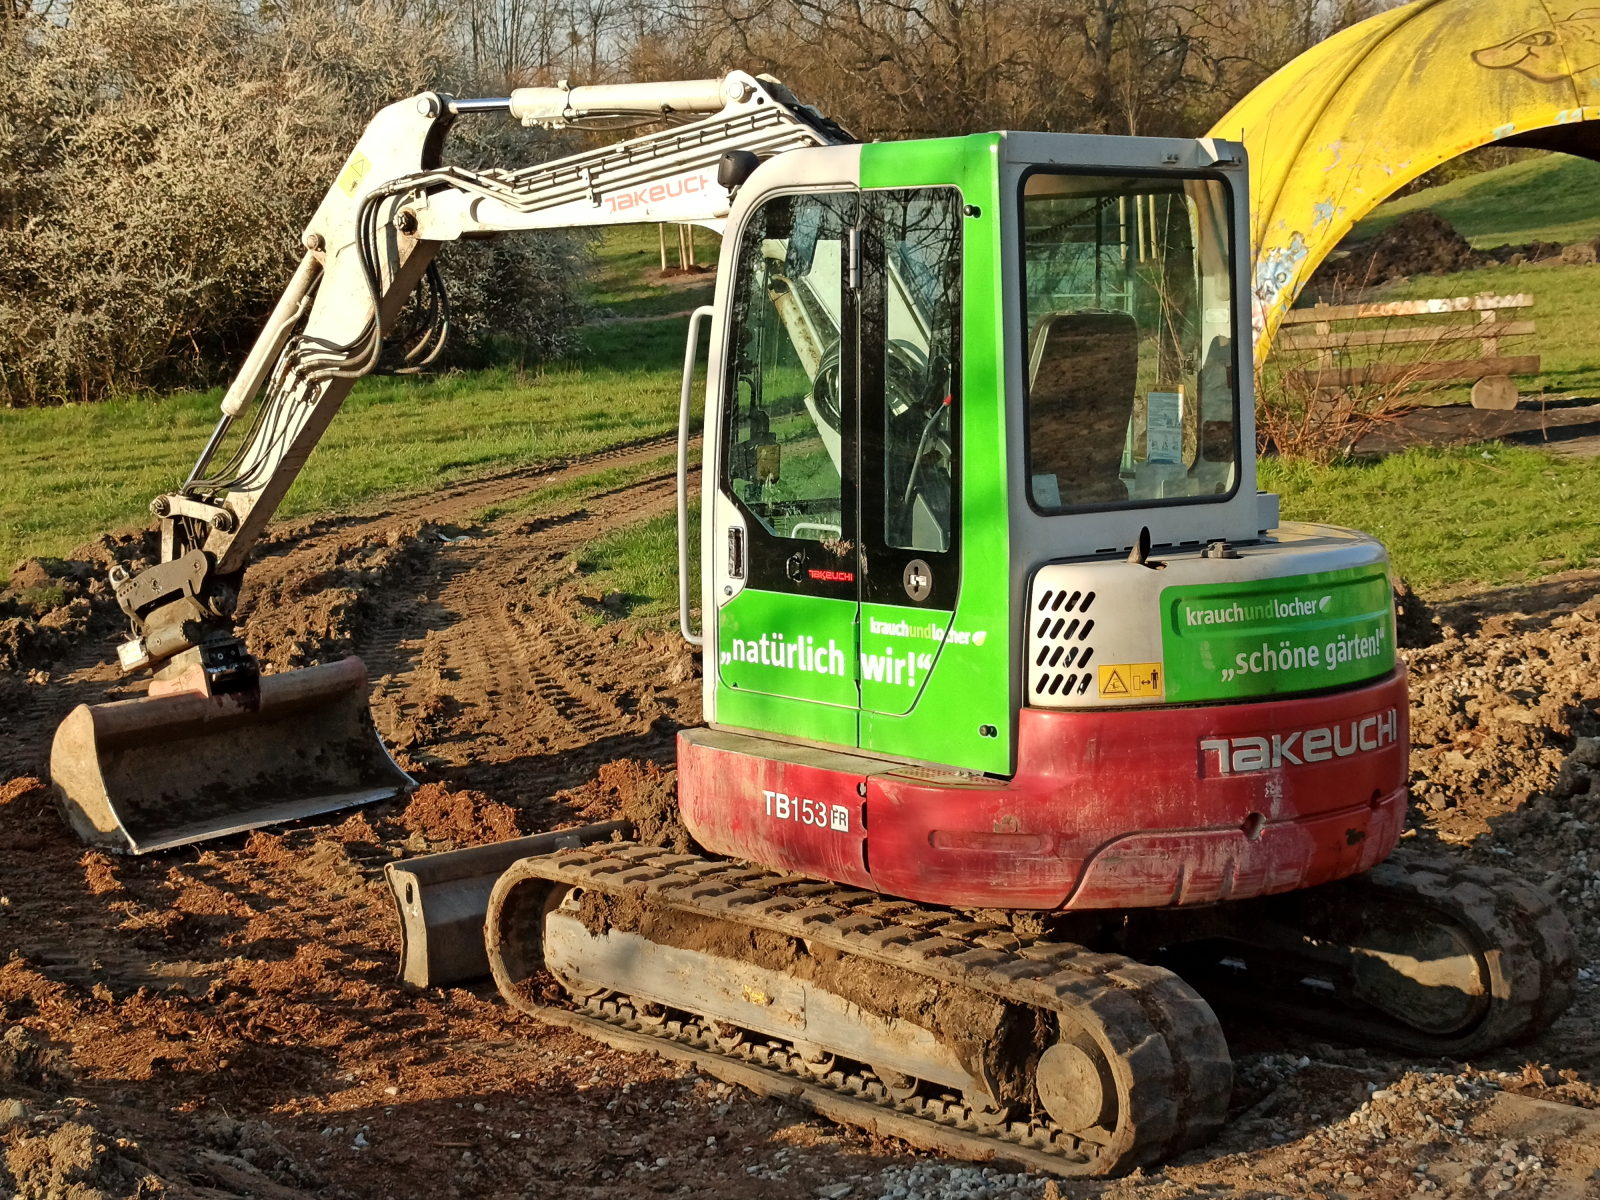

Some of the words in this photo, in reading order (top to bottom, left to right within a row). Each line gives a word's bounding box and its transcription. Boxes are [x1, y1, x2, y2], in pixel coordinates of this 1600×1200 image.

[1186, 596, 1317, 626] krauchundlocher
[1201, 708, 1397, 773] TAKEUCHI
[763, 790, 828, 827] TB153
